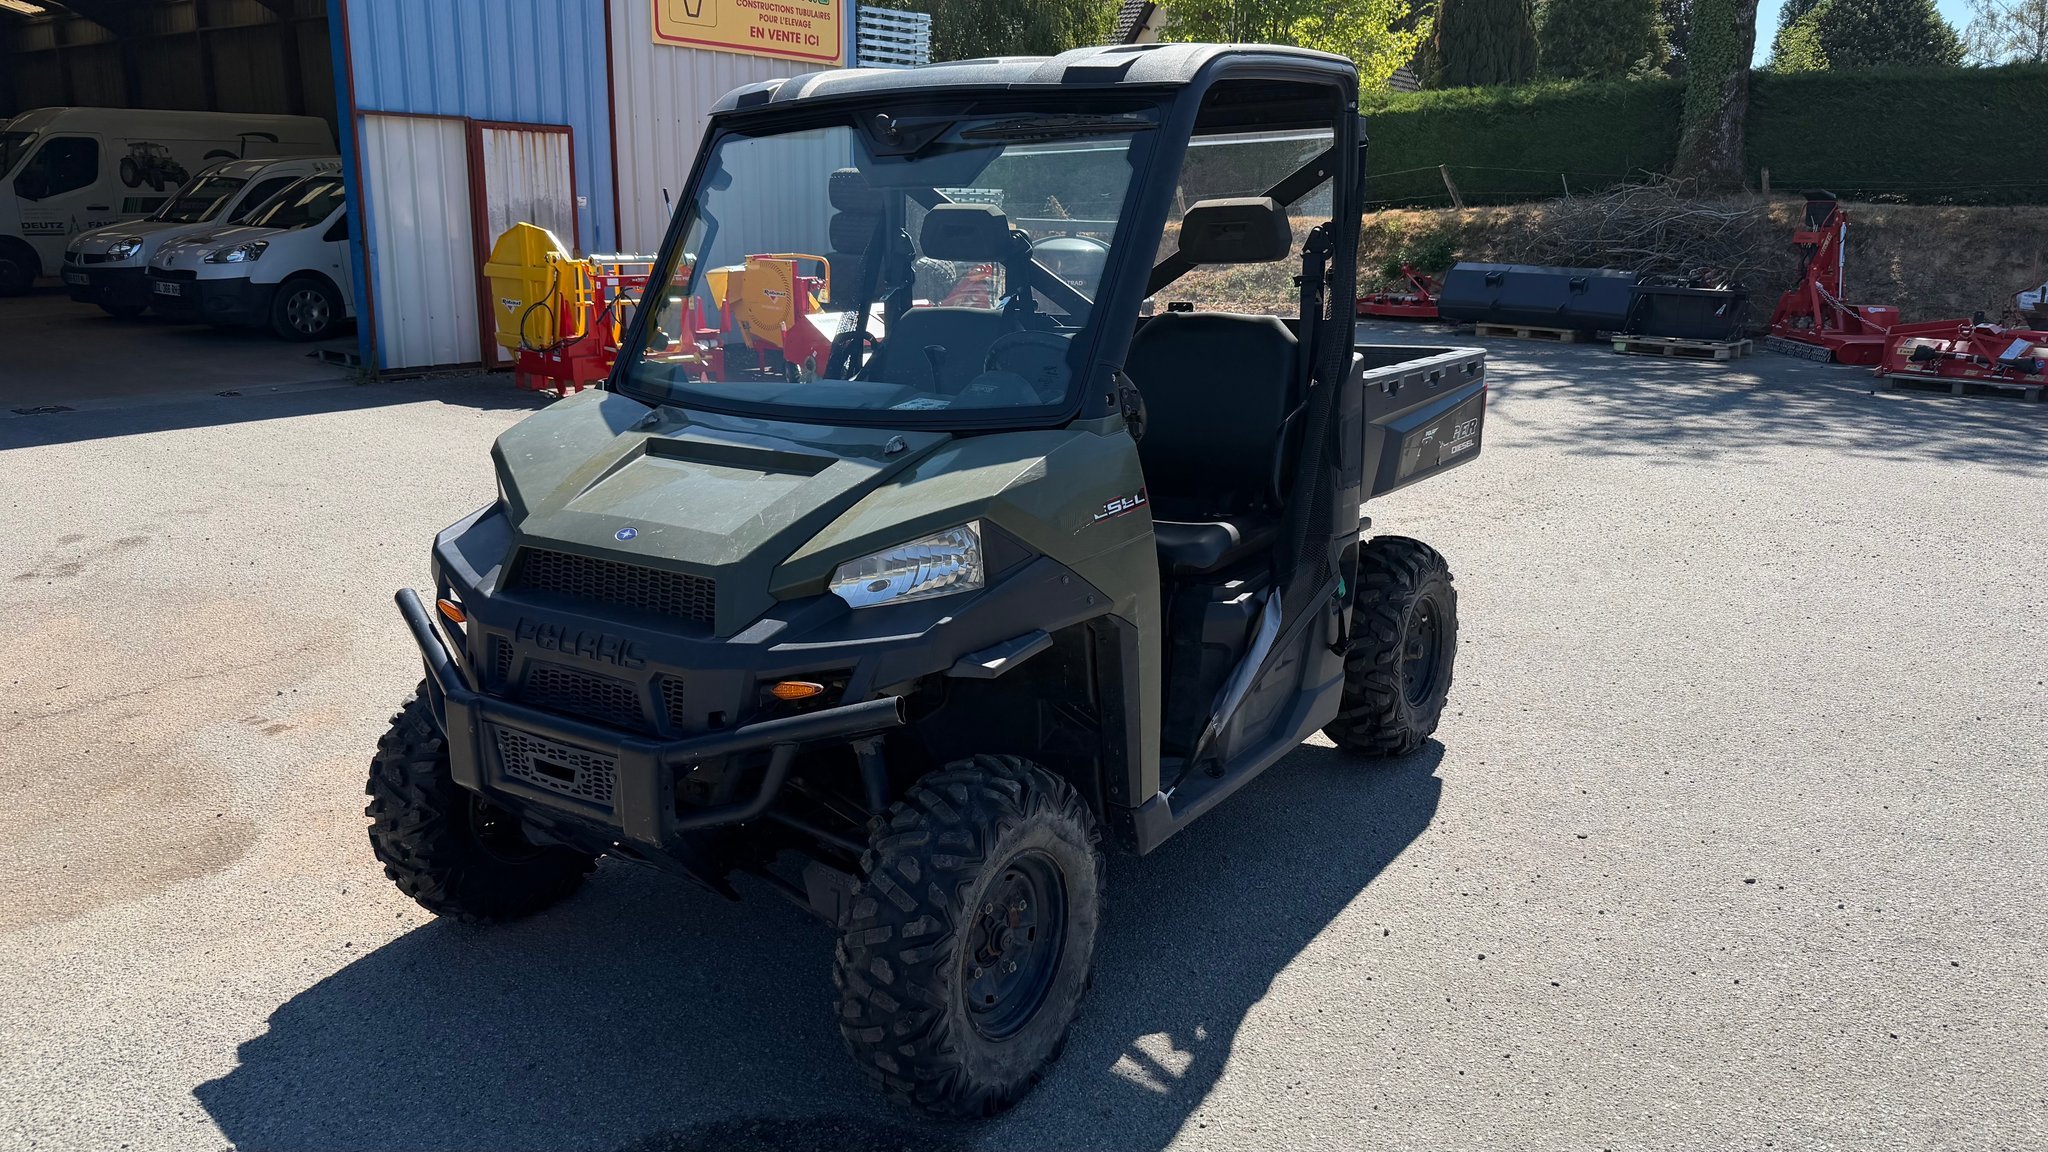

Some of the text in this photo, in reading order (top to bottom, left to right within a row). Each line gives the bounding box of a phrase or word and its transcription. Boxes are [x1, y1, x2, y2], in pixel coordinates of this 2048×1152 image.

[736, 0, 794, 14] CONSTRUCTIONS
[795, 7, 831, 21] TUBULAIRES
[759, 13, 812, 29] POUR L'ELEVAGE
[750, 26, 820, 46] EN VENTE ICI
[21, 221, 64, 229] DEUTZ
[515, 616, 647, 671] POLARIS
